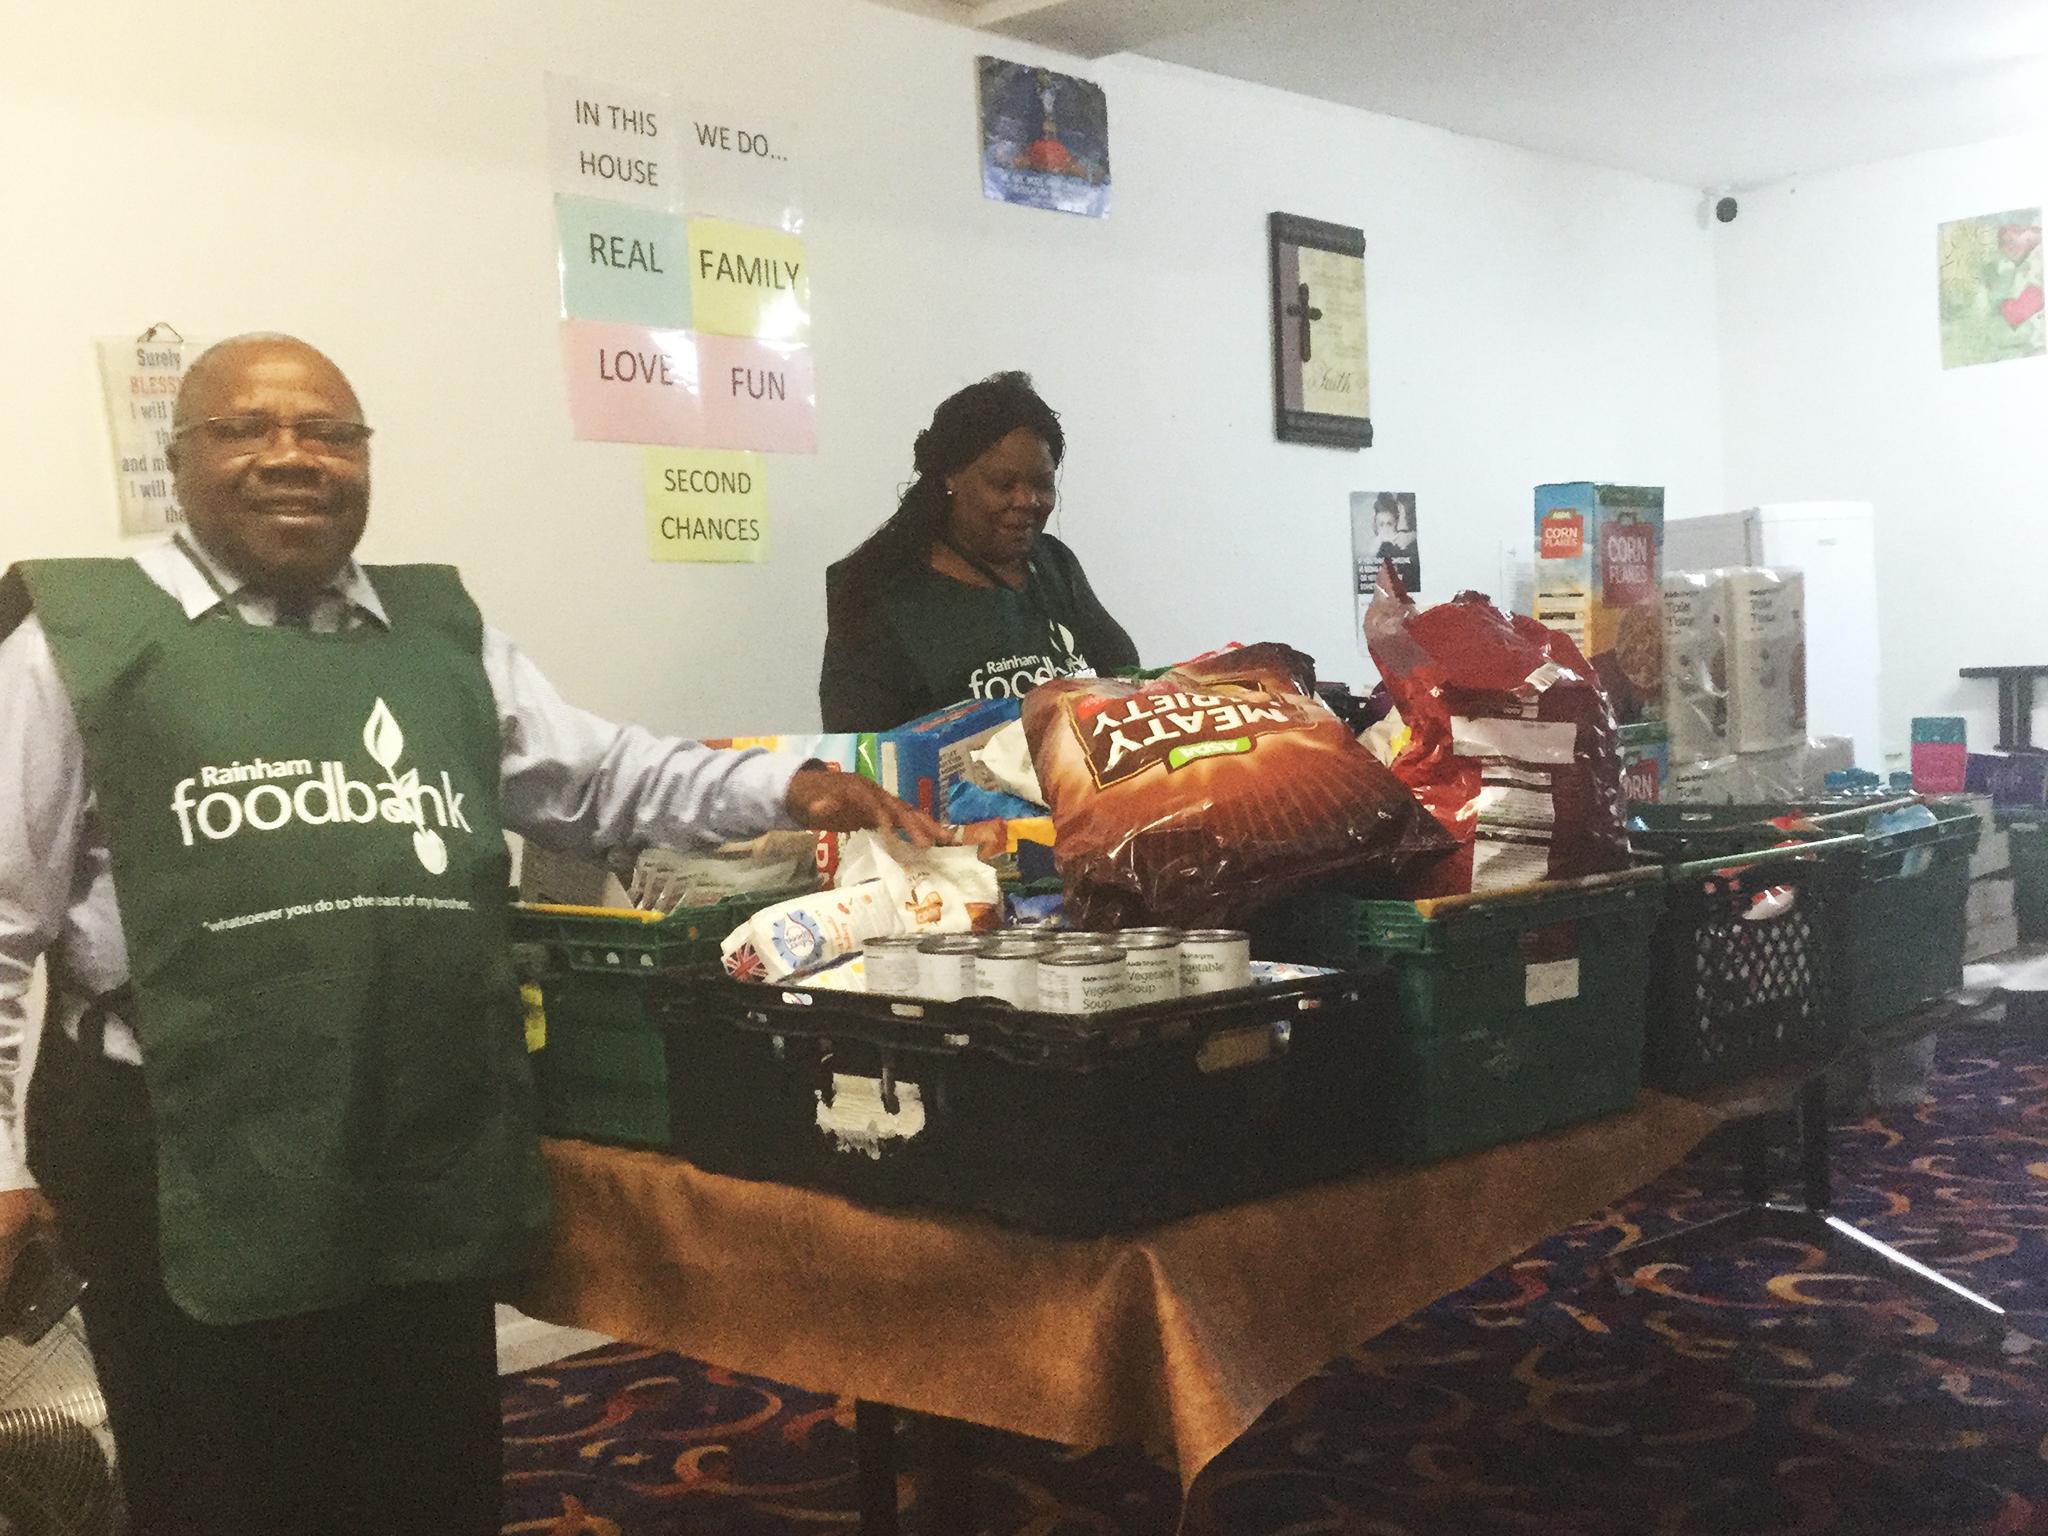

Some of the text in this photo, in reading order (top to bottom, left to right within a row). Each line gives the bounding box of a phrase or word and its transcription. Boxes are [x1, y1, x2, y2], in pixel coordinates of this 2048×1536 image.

[575, 100, 658, 137] IN THIS
[694, 121, 788, 161] WE DO...
[580, 151, 659, 187] HOUSE
[590, 233, 664, 274] REAL
[699, 249, 800, 291] FAMILY
[137, 348, 181, 371] Surely
[600, 348, 675, 386] LOVE
[129, 376, 179, 394] BLESS
[731, 367, 786, 401] FUN
[141, 400, 168, 418] will
[122, 454, 147, 472] and
[140, 479, 166, 497] will
[664, 468, 752, 494] SECOND
[661, 516, 760, 541] CHANCES
[1544, 527, 1578, 540] CORN
[1607, 535, 1649, 563] CORN
[986, 654, 1040, 675] Rainham
[1102, 702, 1289, 773] MEATY
[202, 758, 313, 788] Rainham
[171, 760, 473, 846] foodbank
[285, 903, 312, 919] you
[314, 899, 334, 912] do
[336, 898, 351, 910] to
[352, 894, 375, 908] the
[402, 894, 417, 906] of
[1127, 984, 1157, 995] Soup
[1083, 999, 1113, 1011] Soup
